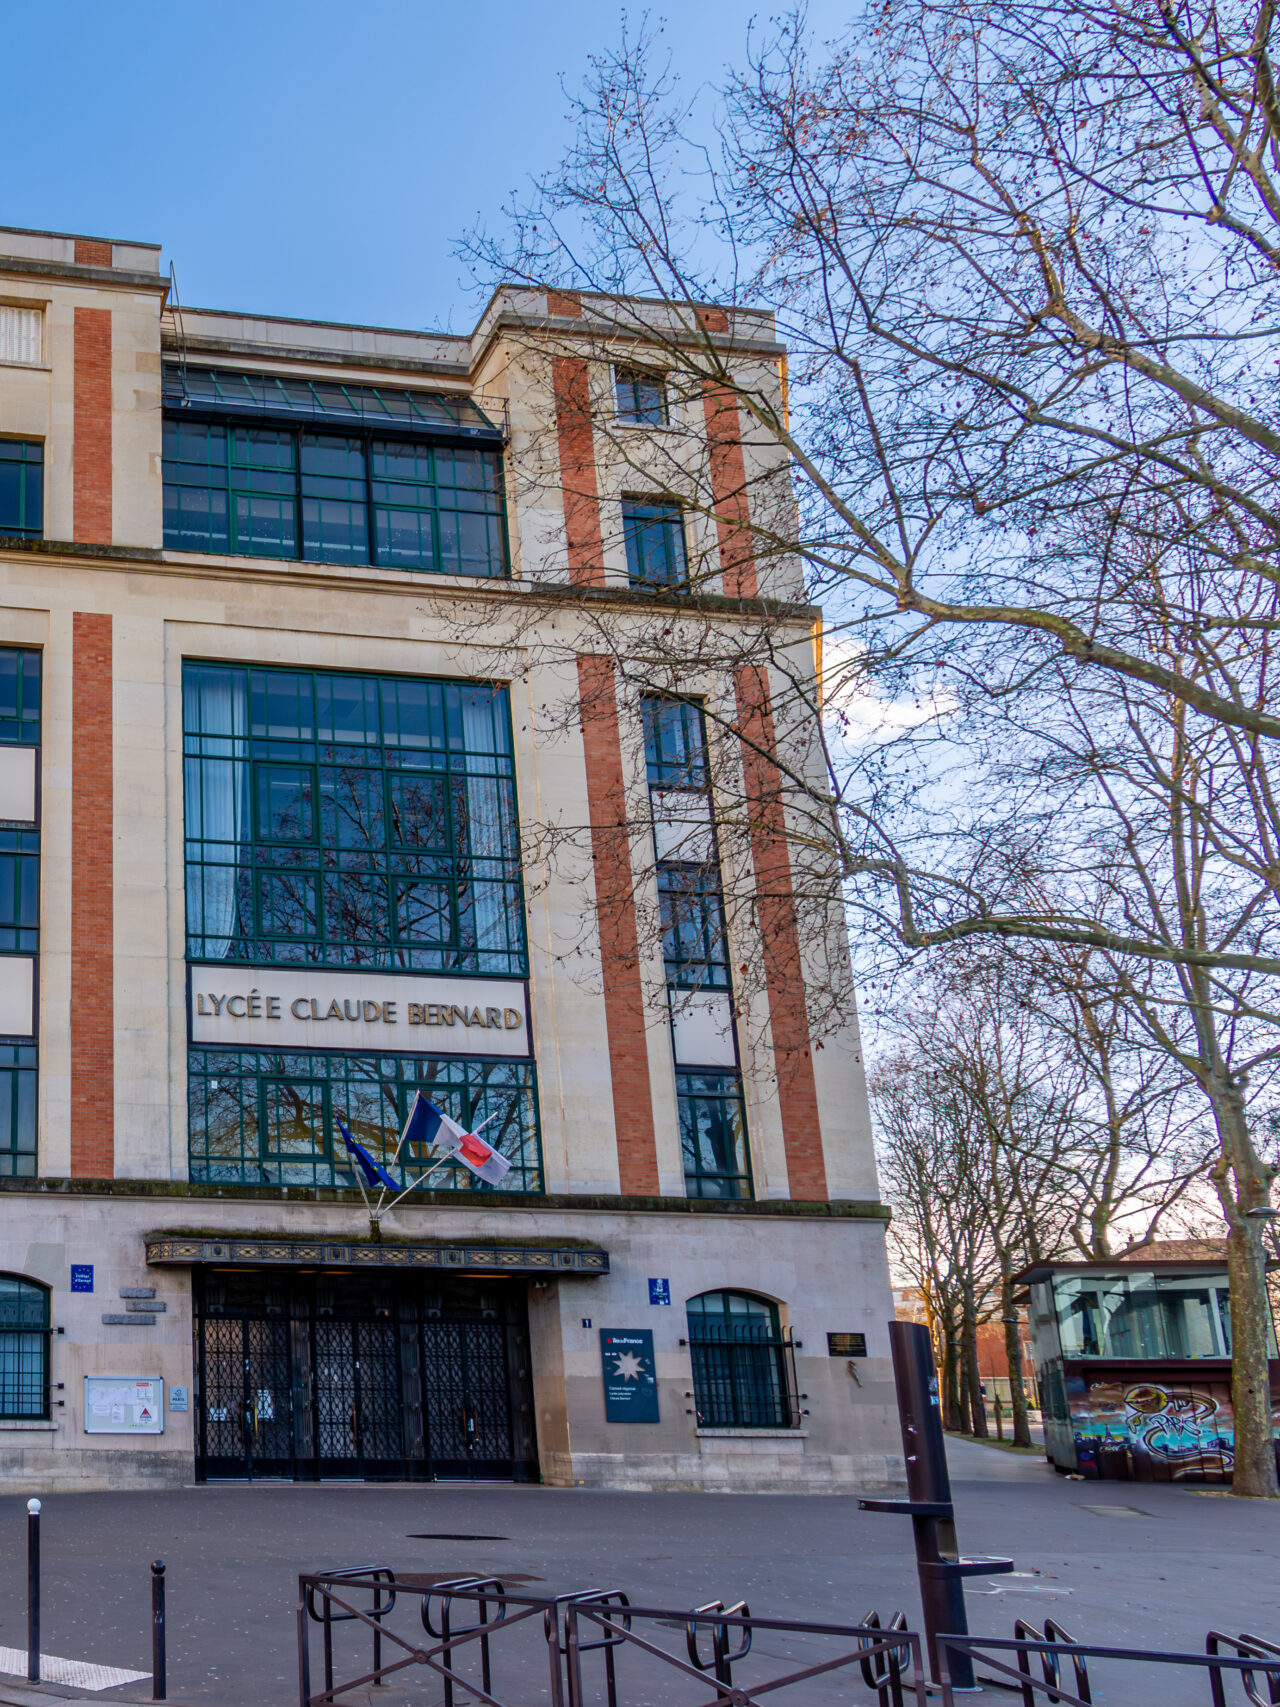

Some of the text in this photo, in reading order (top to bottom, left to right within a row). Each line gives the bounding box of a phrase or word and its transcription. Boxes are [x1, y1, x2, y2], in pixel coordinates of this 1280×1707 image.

[197, 988, 523, 1030] LYCÉE CLAUDE BERNARD
